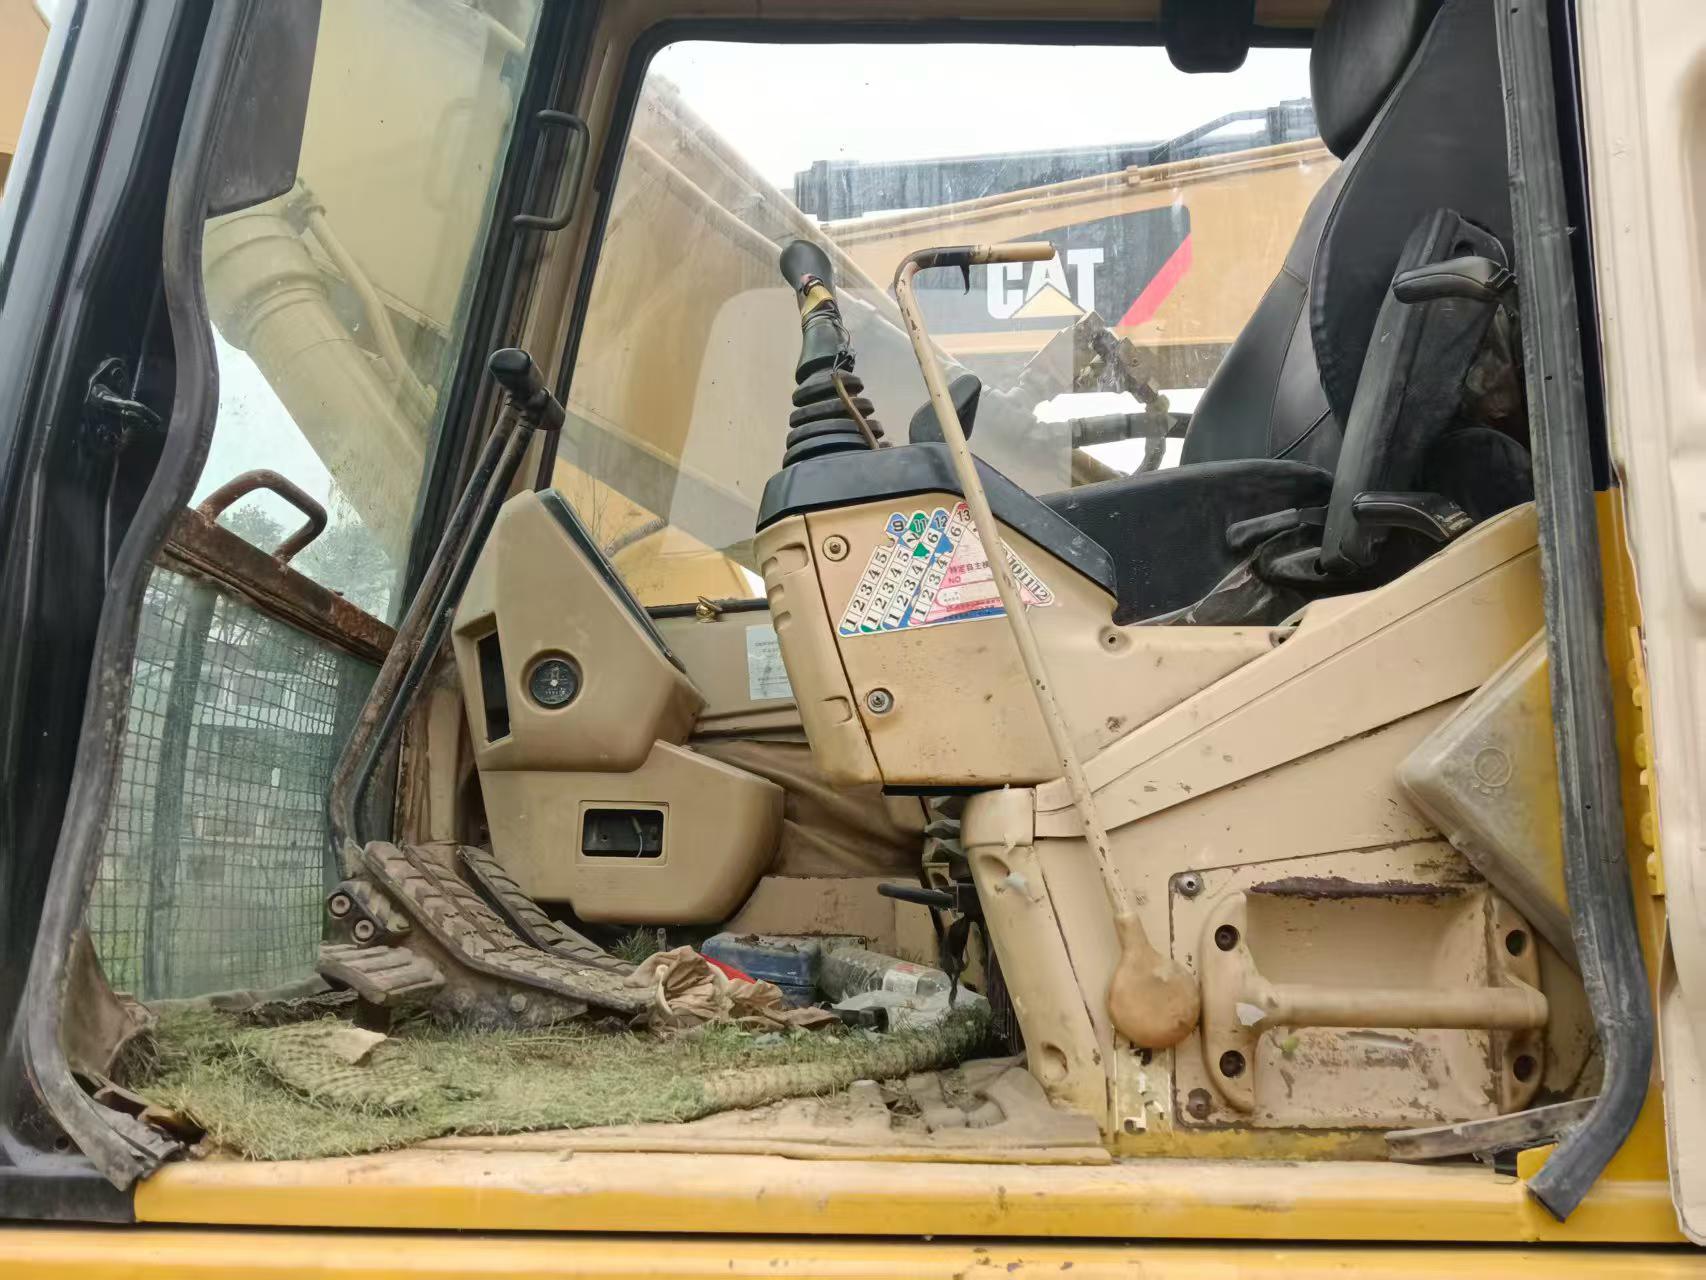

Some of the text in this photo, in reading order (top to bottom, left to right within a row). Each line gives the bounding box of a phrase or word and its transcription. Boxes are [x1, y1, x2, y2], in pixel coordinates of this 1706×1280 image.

[987, 248, 1104, 319] CAT
[935, 515, 948, 528] 12
[957, 510, 971, 521] 13
[915, 519, 927, 534] 11
